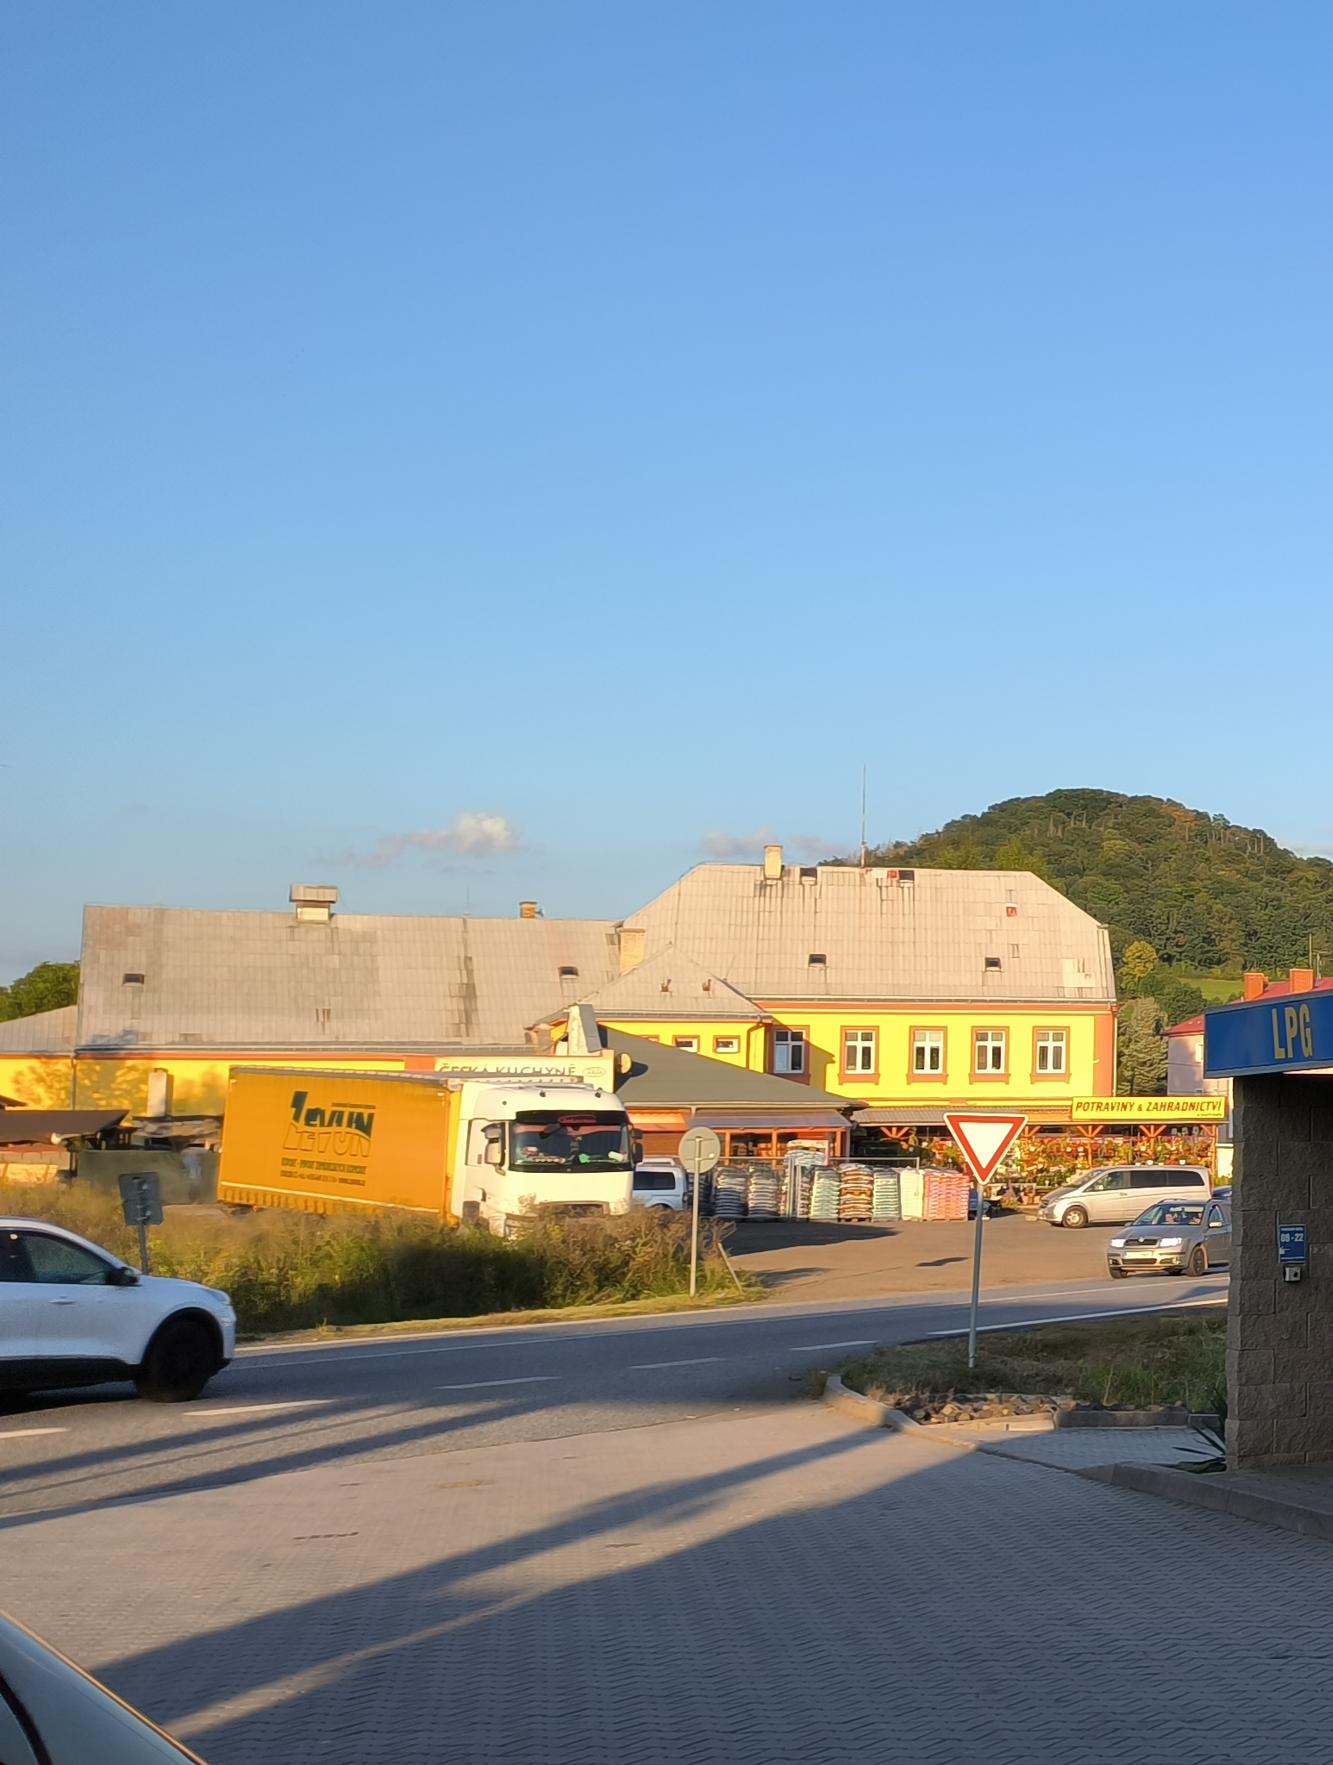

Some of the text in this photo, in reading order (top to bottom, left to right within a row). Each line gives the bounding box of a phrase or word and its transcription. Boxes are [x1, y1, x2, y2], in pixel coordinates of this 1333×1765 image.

[1272, 1003, 1312, 1059] LPG
[1075, 1098, 1222, 1112] POTRAVINY & ZAHRADNICTVÍ
